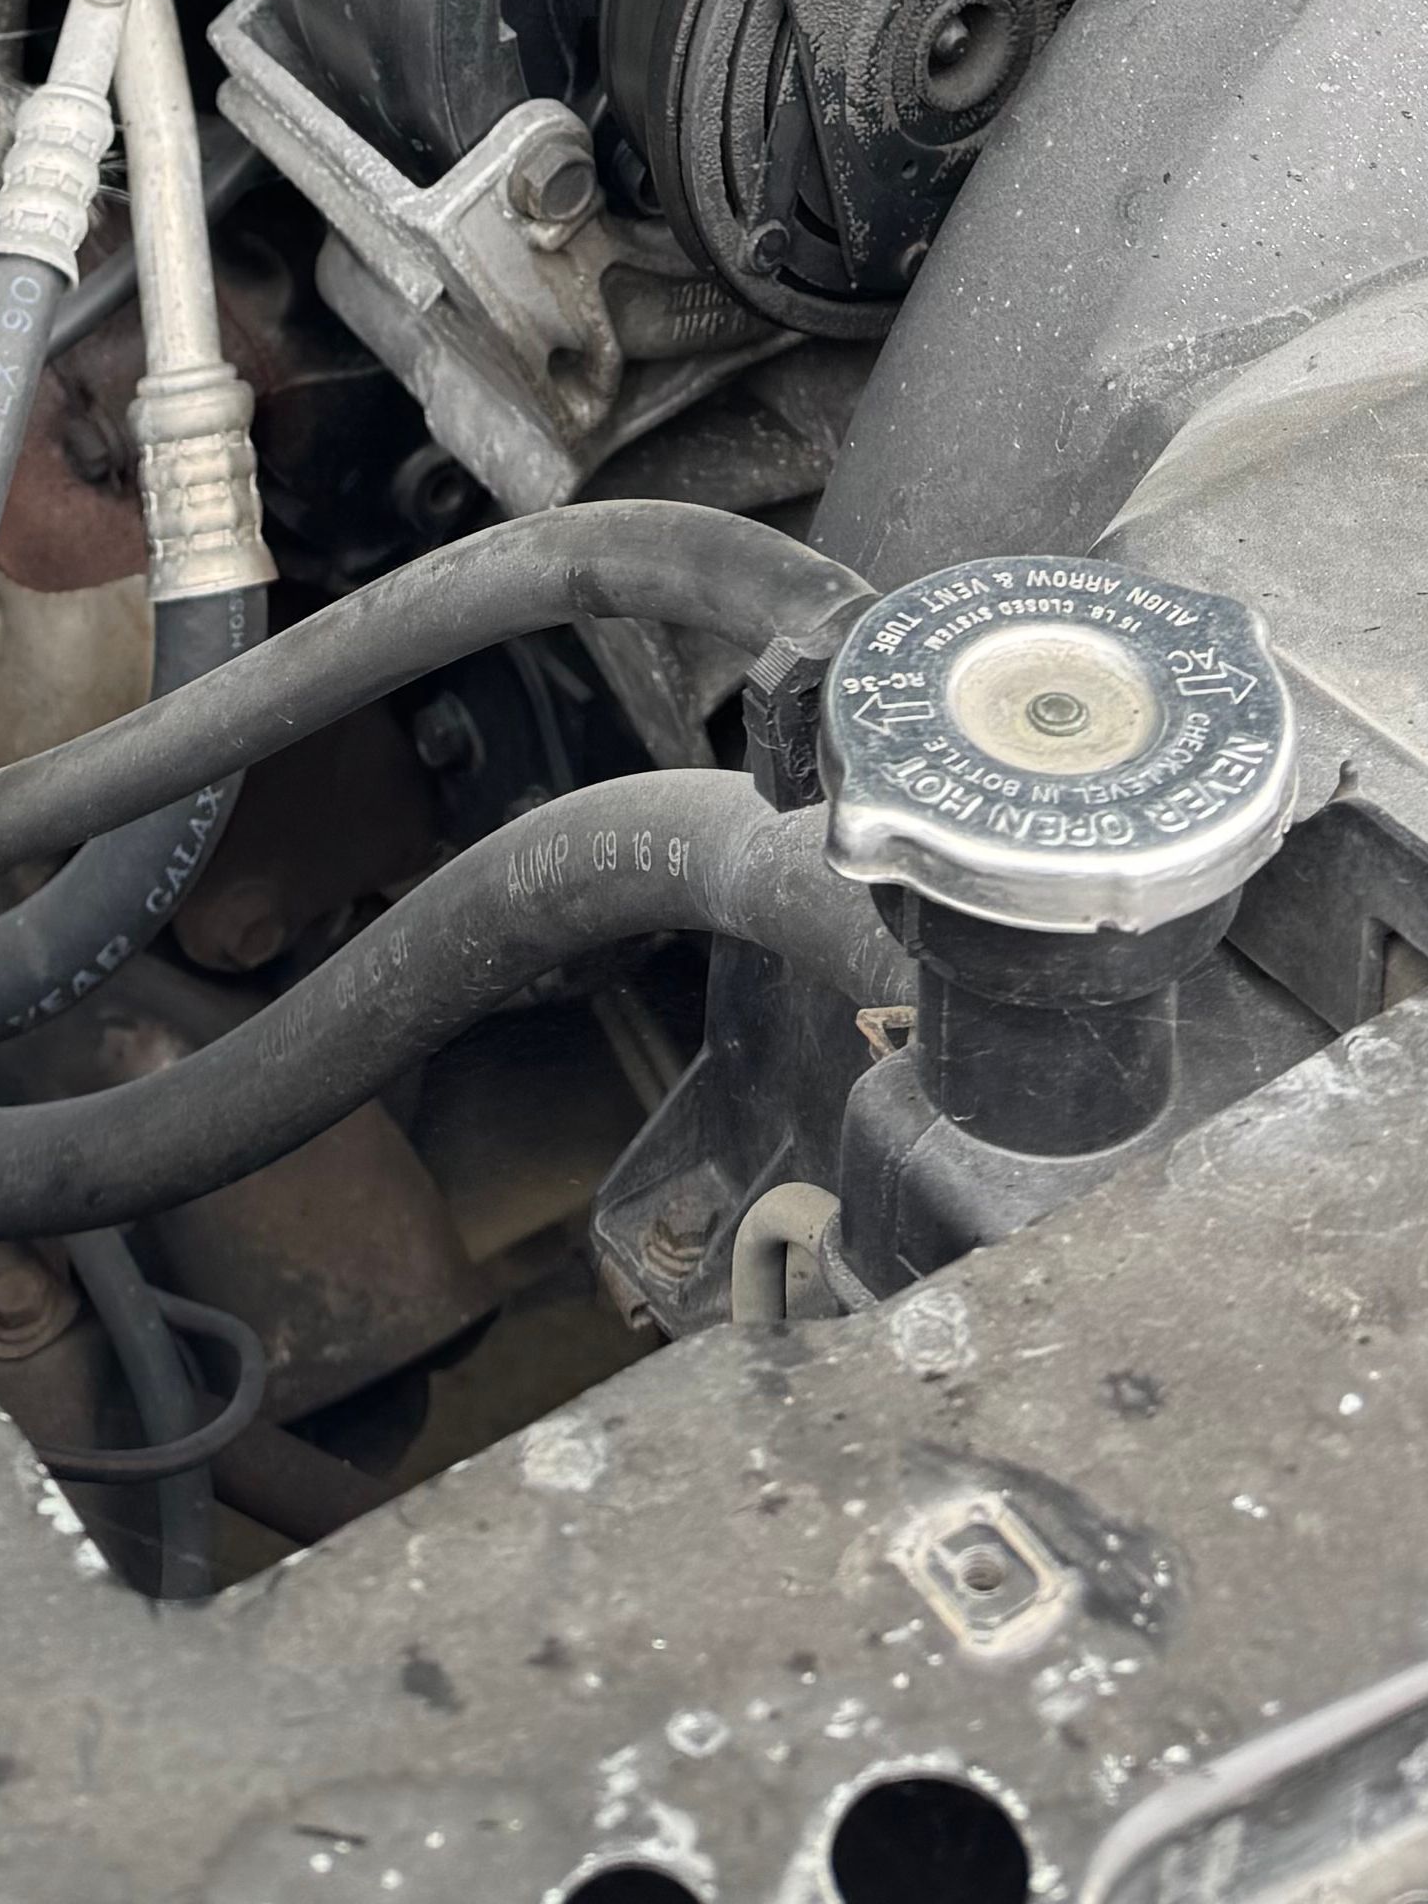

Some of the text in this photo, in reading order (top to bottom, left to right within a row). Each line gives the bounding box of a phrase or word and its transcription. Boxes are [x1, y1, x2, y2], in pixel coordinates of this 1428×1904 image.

[867, 568, 1199, 657] ALIGN ARROW & VENT TUBE
[922, 602, 995, 654] SYSTEM
[997, 598, 1075, 616] CLOSED
[1089, 602, 1117, 623] LB.
[1166, 645, 1216, 676] AC
[840, 670, 926, 696] RC-36
[923, 710, 1212, 805] CHECK LEVEL IN BOTTLE
[880, 730, 1272, 848] NEVER OPEN HOT
[591, 830, 619, 872] 09
[632, 830, 653, 873] 16
